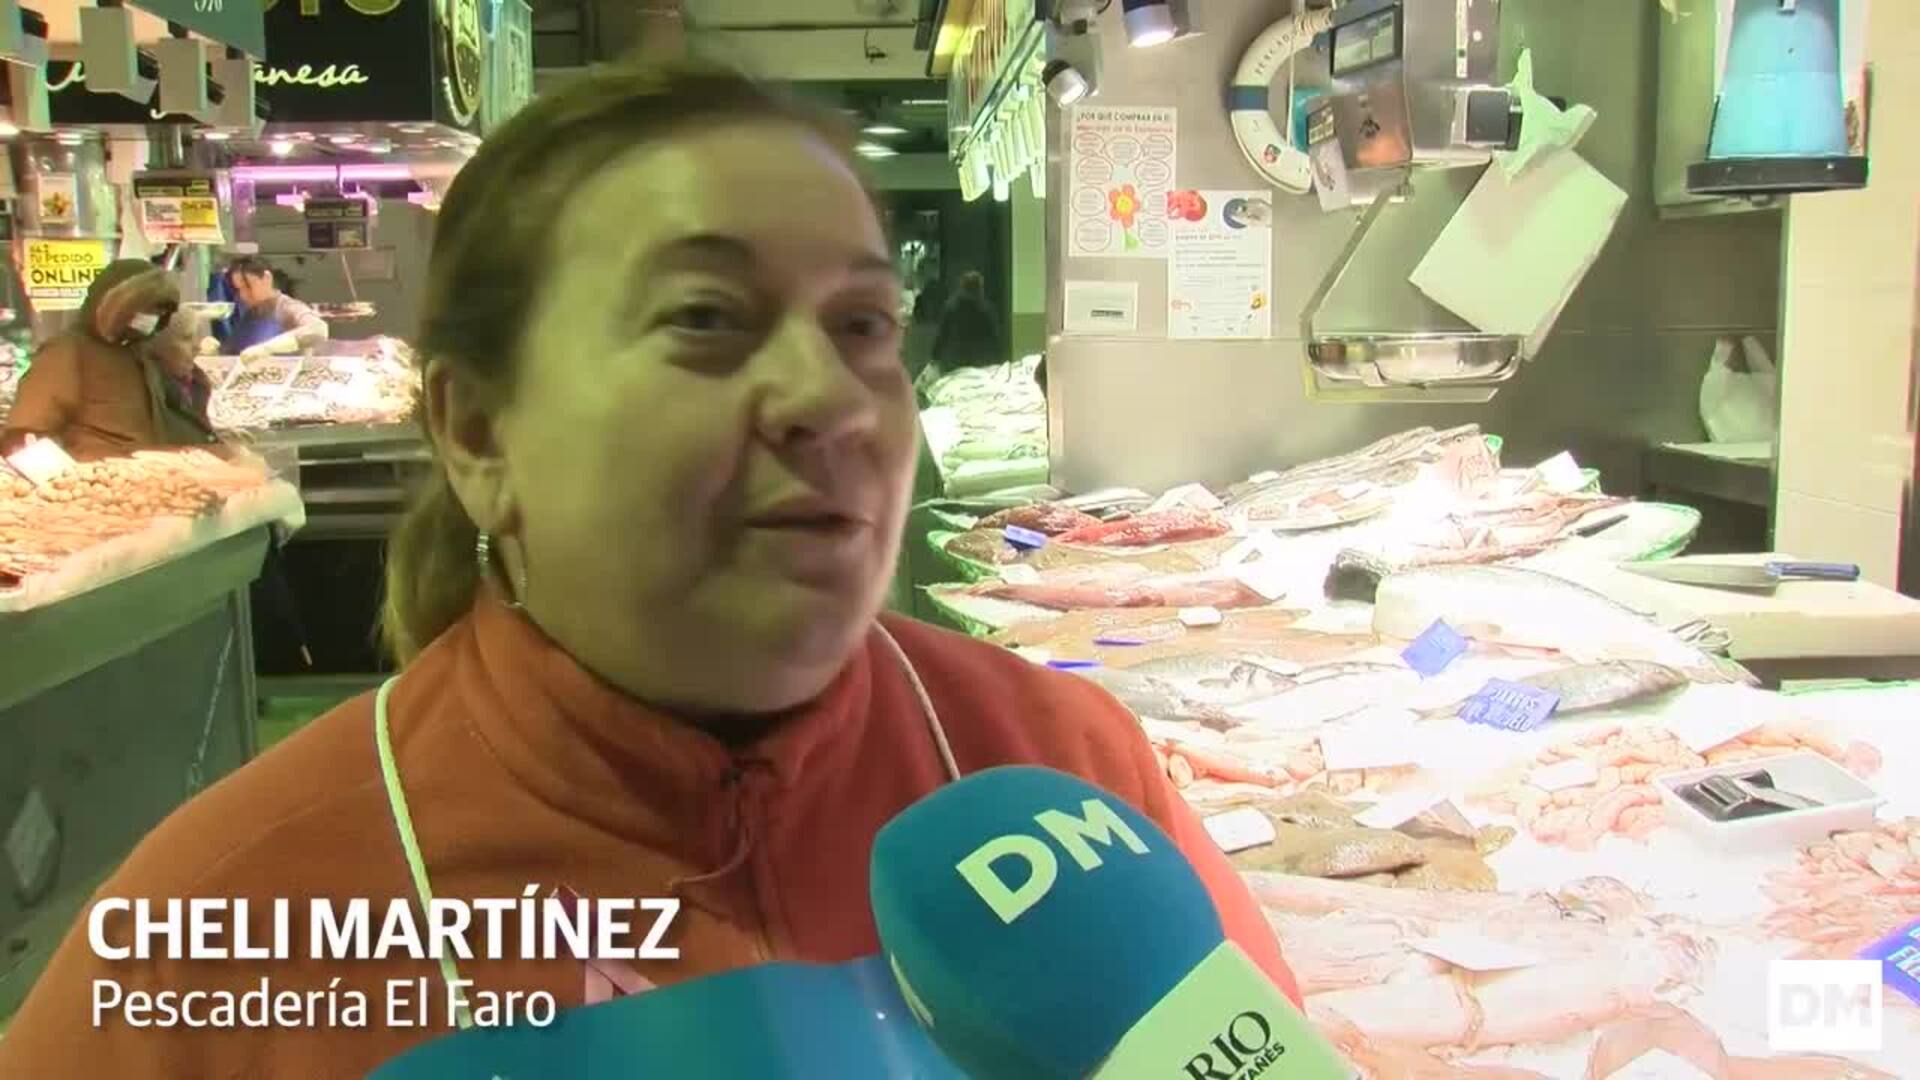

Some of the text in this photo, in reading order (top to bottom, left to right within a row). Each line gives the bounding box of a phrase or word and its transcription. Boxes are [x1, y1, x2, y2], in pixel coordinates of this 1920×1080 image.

[253, 64, 369, 87] anesa
[45, 253, 94, 263] PEDIDO
[955, 799, 1150, 925] DM
[1183, 1011, 1271, 1080] RIO
